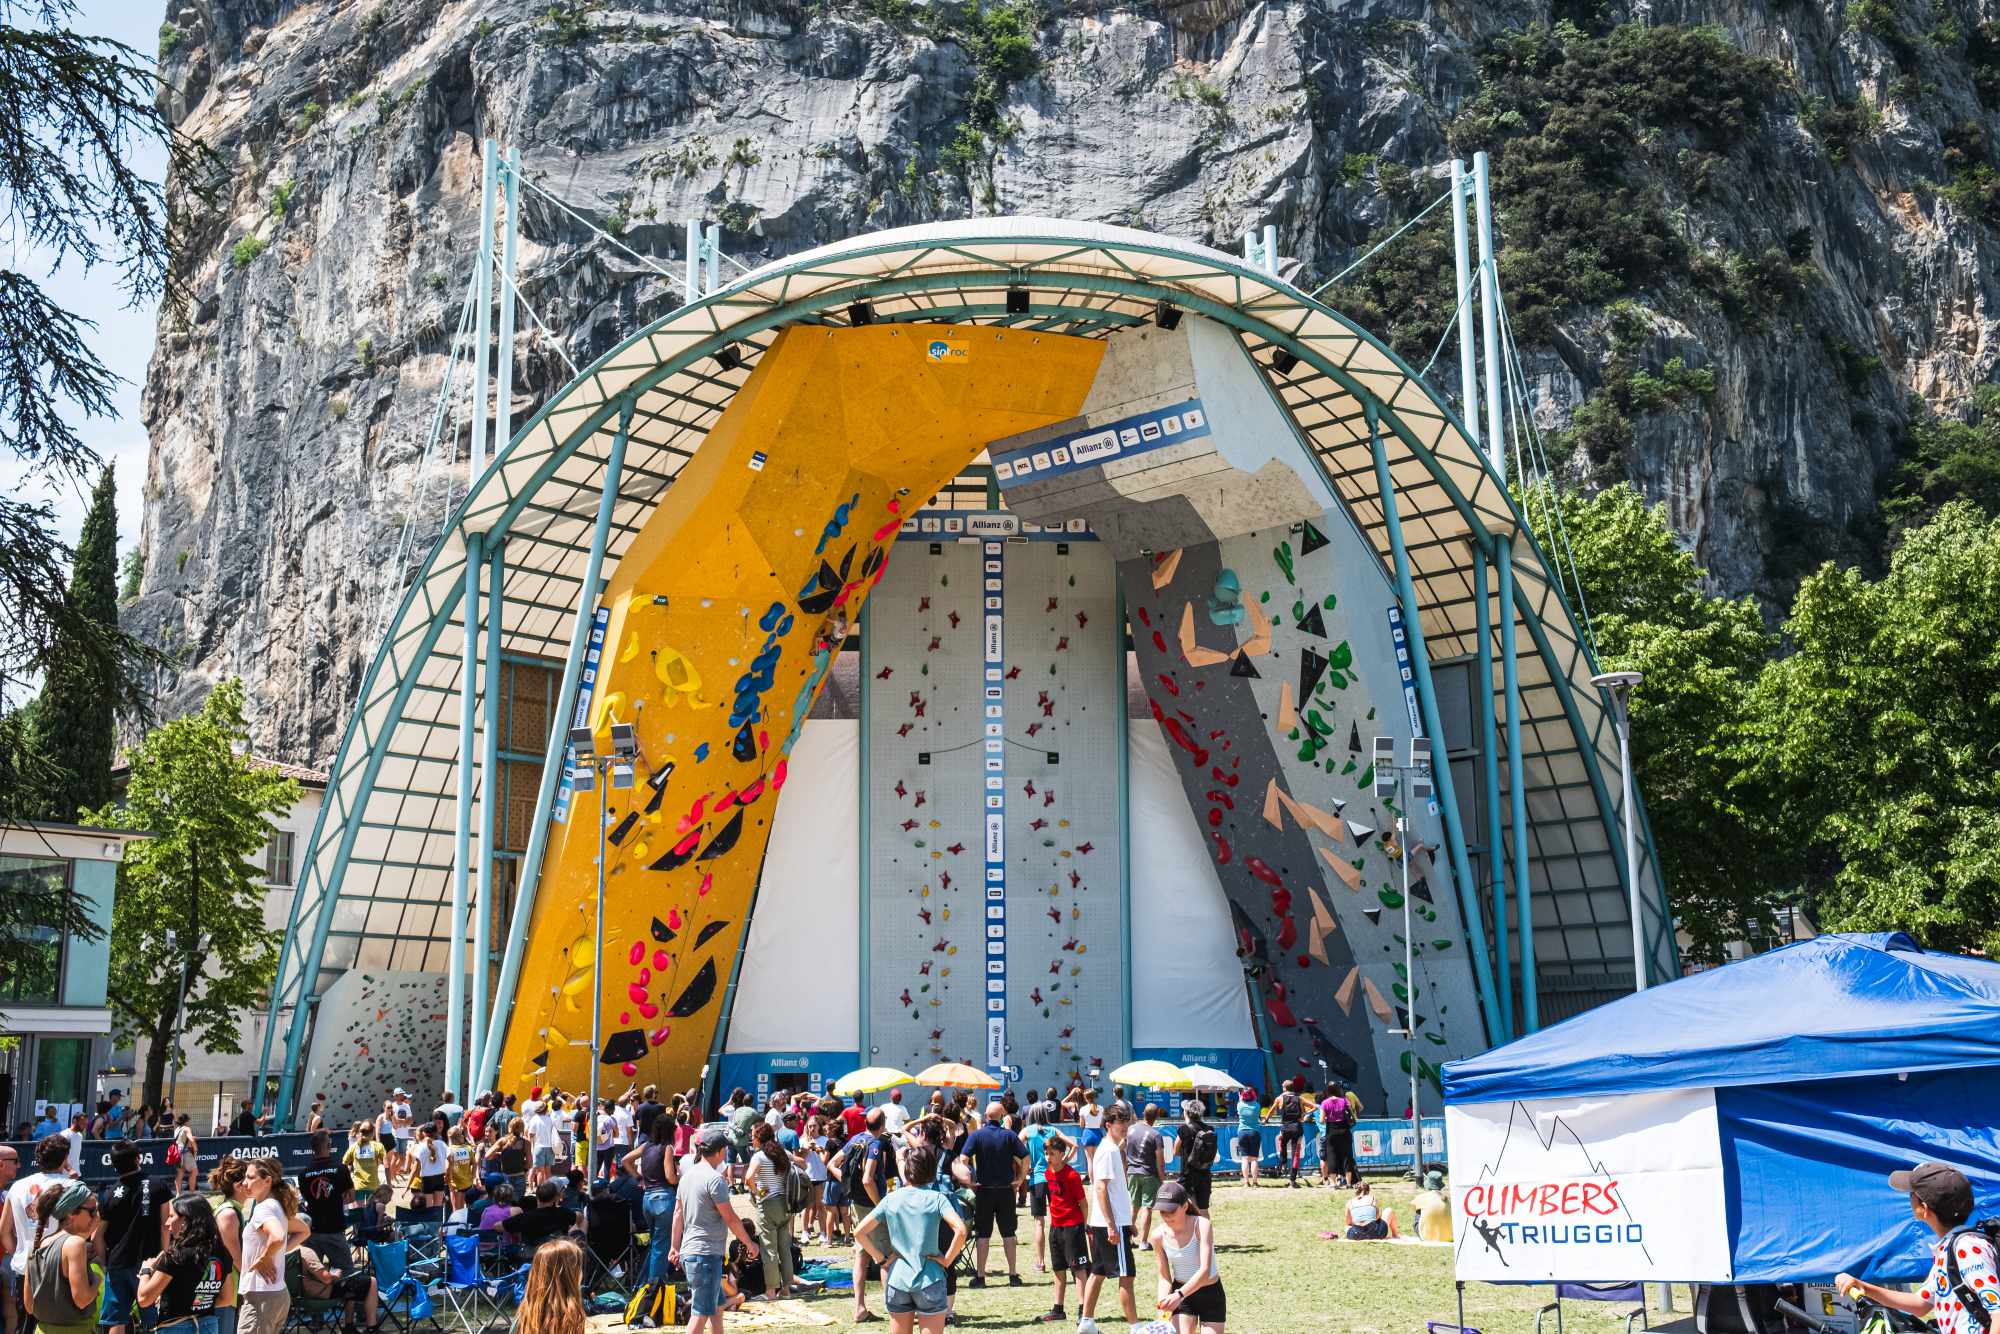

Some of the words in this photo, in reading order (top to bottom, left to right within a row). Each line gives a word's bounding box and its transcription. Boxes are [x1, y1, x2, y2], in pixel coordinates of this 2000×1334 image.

[1076, 442, 1102, 456] Allianz
[972, 520, 1000, 530] Allianz
[770, 1058, 797, 1067] Allianz
[1182, 1054, 1207, 1063] Allianz
[232, 1146, 279, 1160] GARDA
[1464, 1180, 1619, 1218] CLIMBERS
[1501, 1222, 1643, 1245] TRIUGGIO
[1079, 1255, 1088, 1265] 23
[195, 1281, 222, 1290] ARCO
